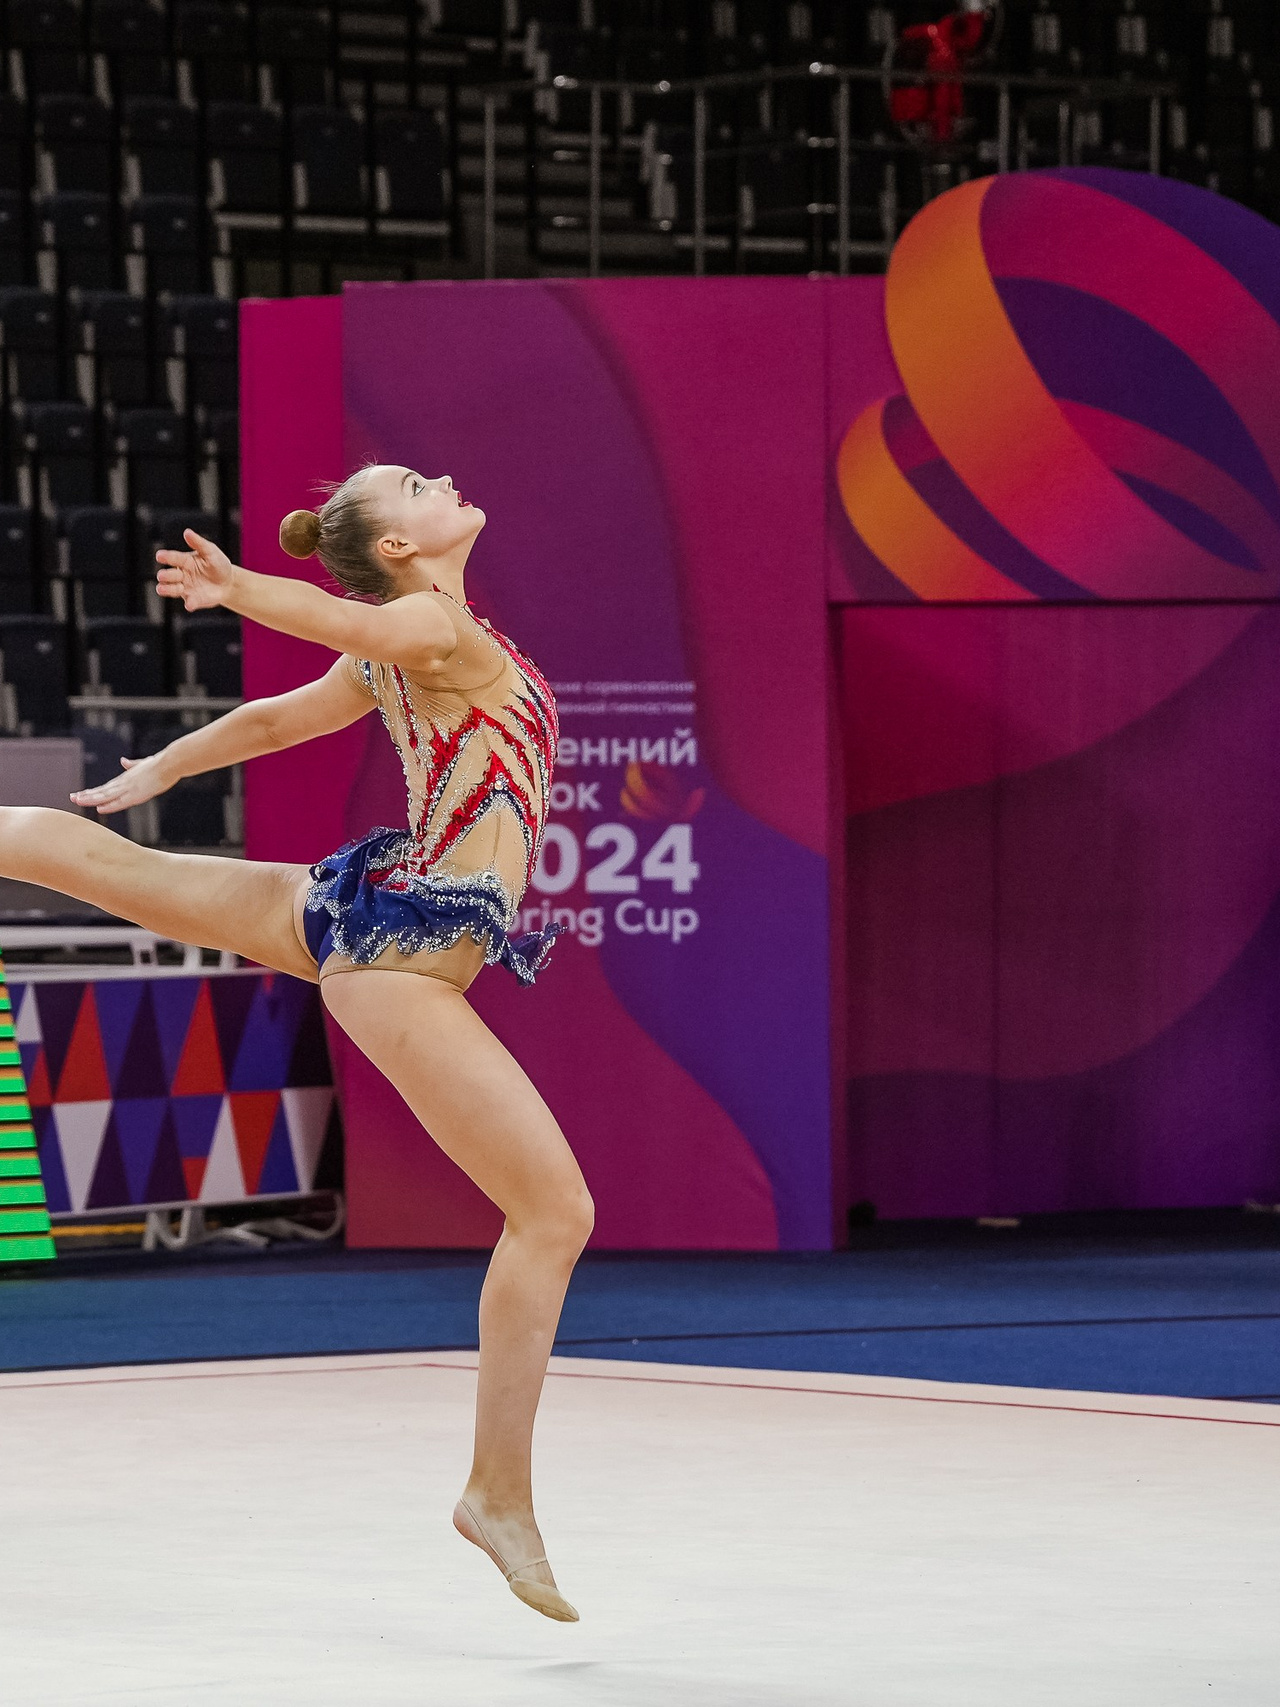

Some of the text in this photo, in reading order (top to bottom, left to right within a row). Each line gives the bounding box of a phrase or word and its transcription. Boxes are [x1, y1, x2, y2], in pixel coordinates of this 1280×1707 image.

[557, 728, 697, 765] енний
[550, 782, 602, 811] ок
[530, 822, 700, 894] 024
[615, 899, 700, 943] Cup
